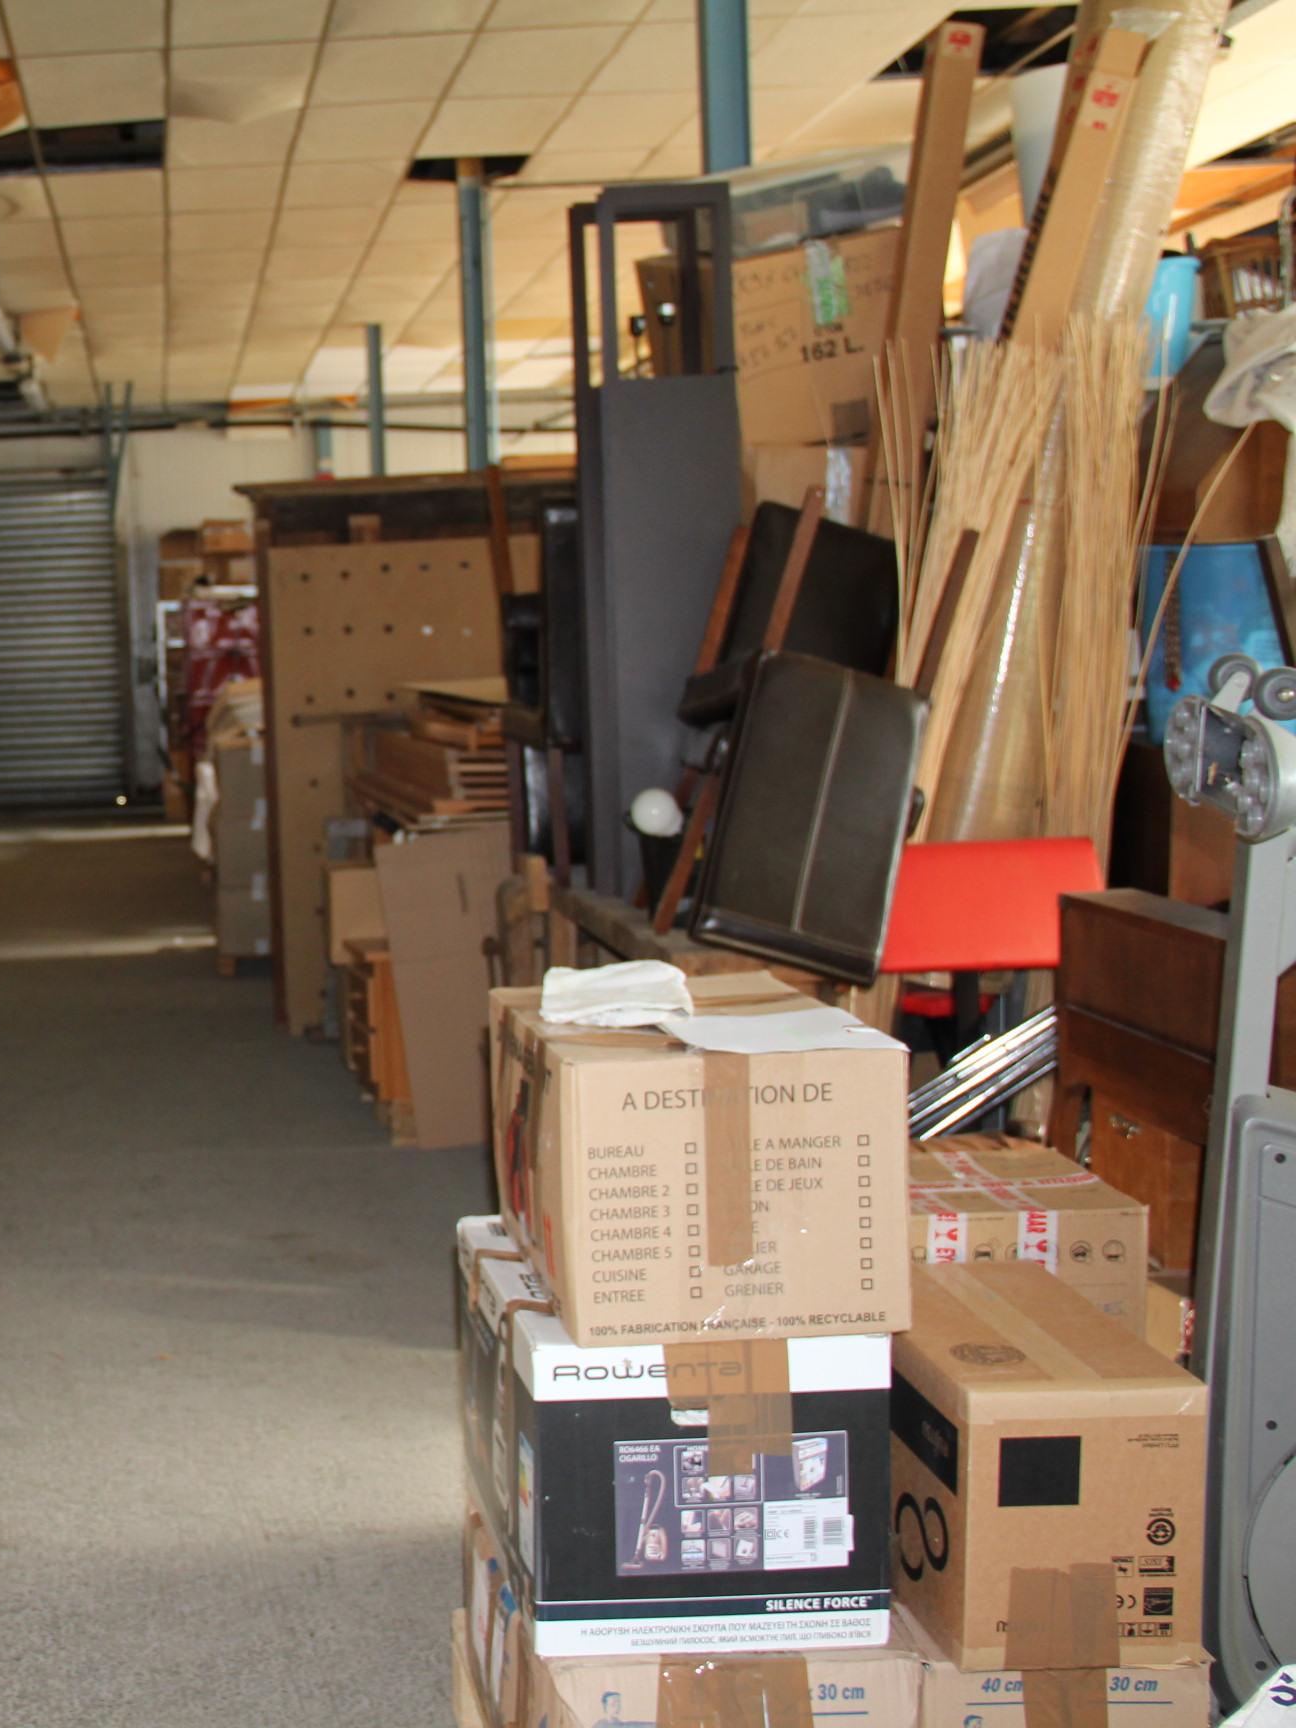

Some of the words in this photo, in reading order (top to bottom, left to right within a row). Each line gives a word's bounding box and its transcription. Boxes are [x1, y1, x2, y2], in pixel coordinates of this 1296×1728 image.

[622, 1092, 637, 1111] A
[644, 1084, 795, 1110] DESTIION
[803, 1082, 833, 1102] DE
[765, 1138, 775, 1150] A
[778, 1135, 842, 1150] MANGER
[587, 1144, 644, 1160] BUREAU
[765, 1158, 784, 1171] DE
[788, 1156, 822, 1170] BAIN
[587, 1164, 657, 1180] CHAMBRE
[588, 1184, 658, 1201] CHAMBRE
[662, 1184, 670, 1197] 2
[766, 1178, 785, 1192] DE
[788, 1177, 824, 1191] JEUX
[589, 1205, 659, 1221] CHAMBRE
[663, 1204, 671, 1218] 3
[590, 1226, 661, 1242] CHAMBRE
[662, 1225, 672, 1238] 4
[591, 1246, 661, 1263] CHAMBRE
[664, 1246, 672, 1259] 5
[592, 1267, 647, 1283] CUISINE
[723, 1261, 783, 1277] GARAGE
[593, 1288, 647, 1304] ENTREE
[724, 1281, 784, 1297] GRENIER
[589, 1324, 618, 1336] 100%
[621, 1320, 697, 1335] FABRICATION
[777, 1315, 805, 1327] 100%
[808, 1311, 886, 1326] RECYCLABLE
[765, 1597, 821, 1612] SILENCE
[817, 1683, 837, 1700] 30
[842, 1686, 865, 1700] cm
[981, 1677, 1002, 1693] 40
[1109, 1676, 1131, 1692] 30
[1134, 1679, 1159, 1692] cm
